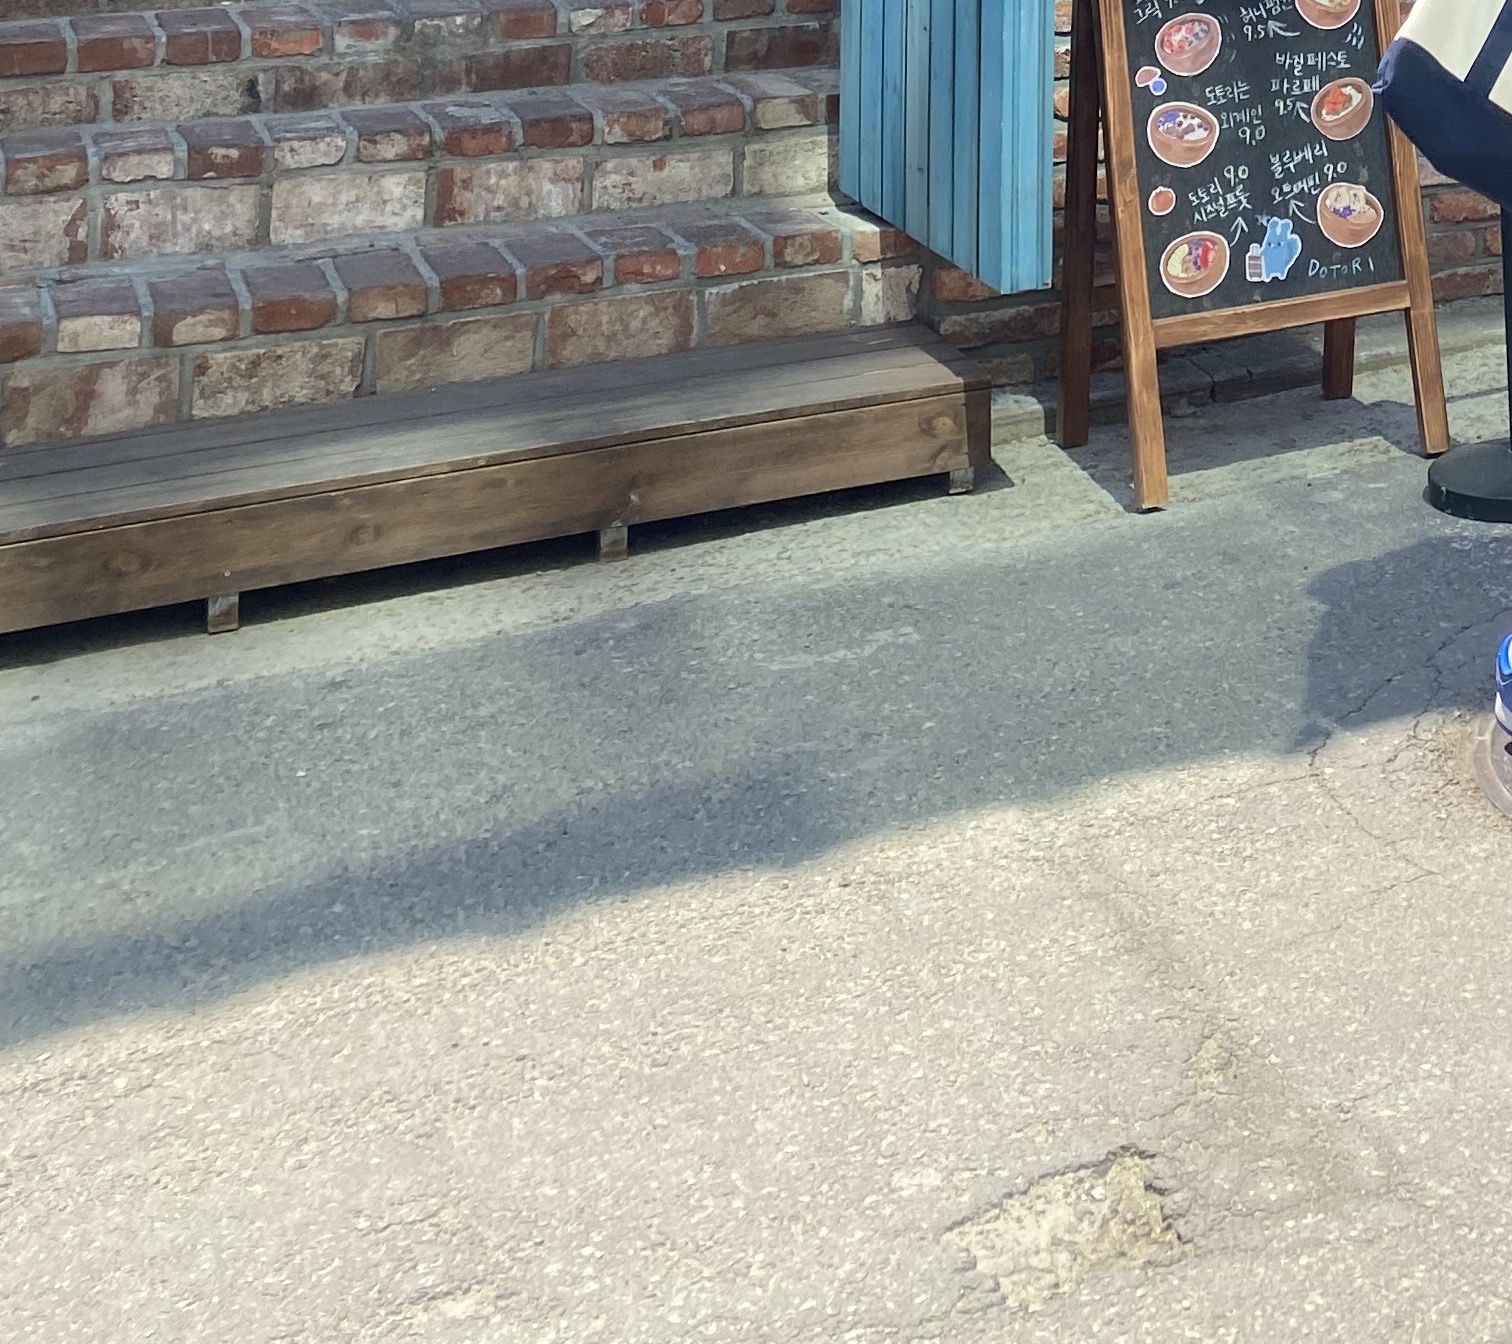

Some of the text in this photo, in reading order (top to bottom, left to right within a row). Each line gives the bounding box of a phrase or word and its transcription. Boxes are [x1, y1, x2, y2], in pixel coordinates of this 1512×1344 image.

[1243, 24, 1267, 42] 9.5
[1205, 80, 1251, 106] 도토리는
[1270, 74, 1320, 95] 파르페
[1274, 96, 1297, 116] 9.5
[1220, 104, 1263, 130] 외계인
[1238, 125, 1266, 146] 9.0
[1269, 139, 1328, 180] 블루베리
[1323, 161, 1348, 182] 9.0
[1188, 165, 1249, 206] 도토리 9.0
